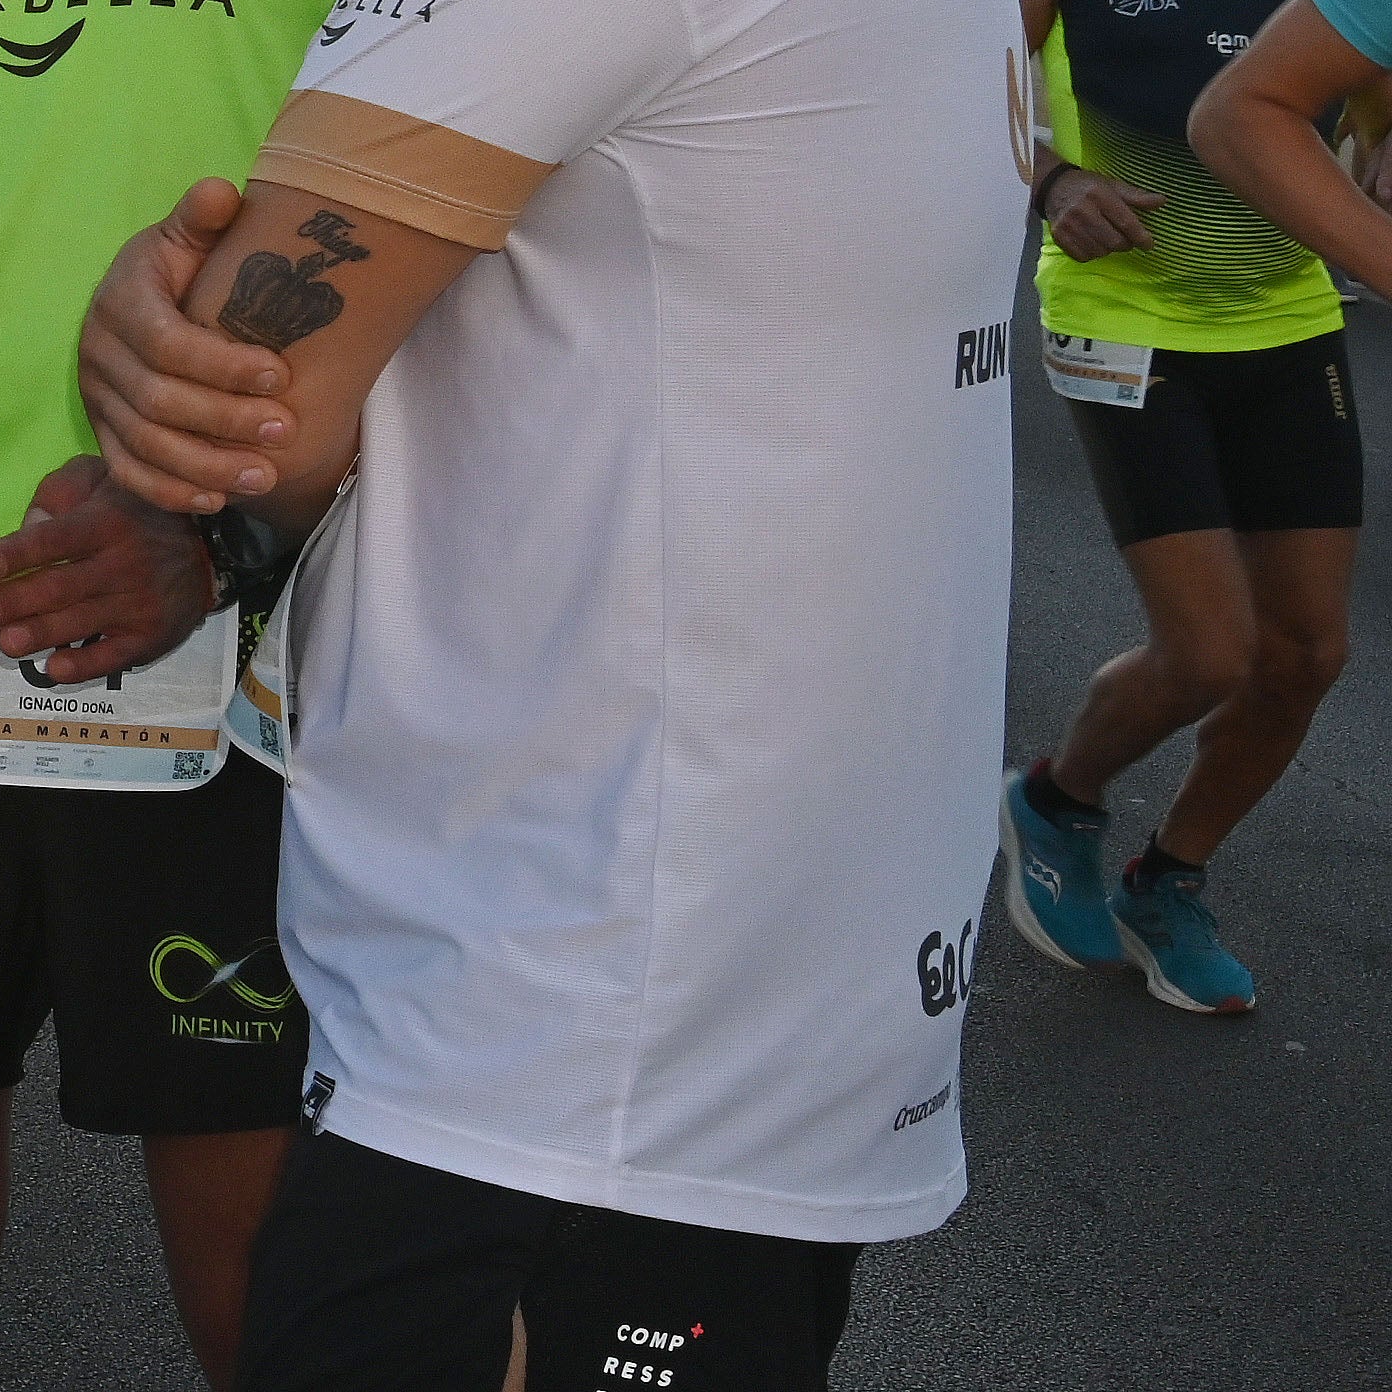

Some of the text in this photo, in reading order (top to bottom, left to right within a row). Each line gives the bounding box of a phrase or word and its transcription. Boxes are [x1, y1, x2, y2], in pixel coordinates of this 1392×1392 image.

[1206, 30, 1251, 55] dem
[954, 321, 1007, 389] RUN
[19, 696, 114, 715] IGNACIO DOÑA
[36, 724, 172, 744] MARATÓN
[171, 1013, 284, 1043] INFINITY
[617, 1324, 685, 1352] COMP
[603, 1356, 674, 1387] RESS
